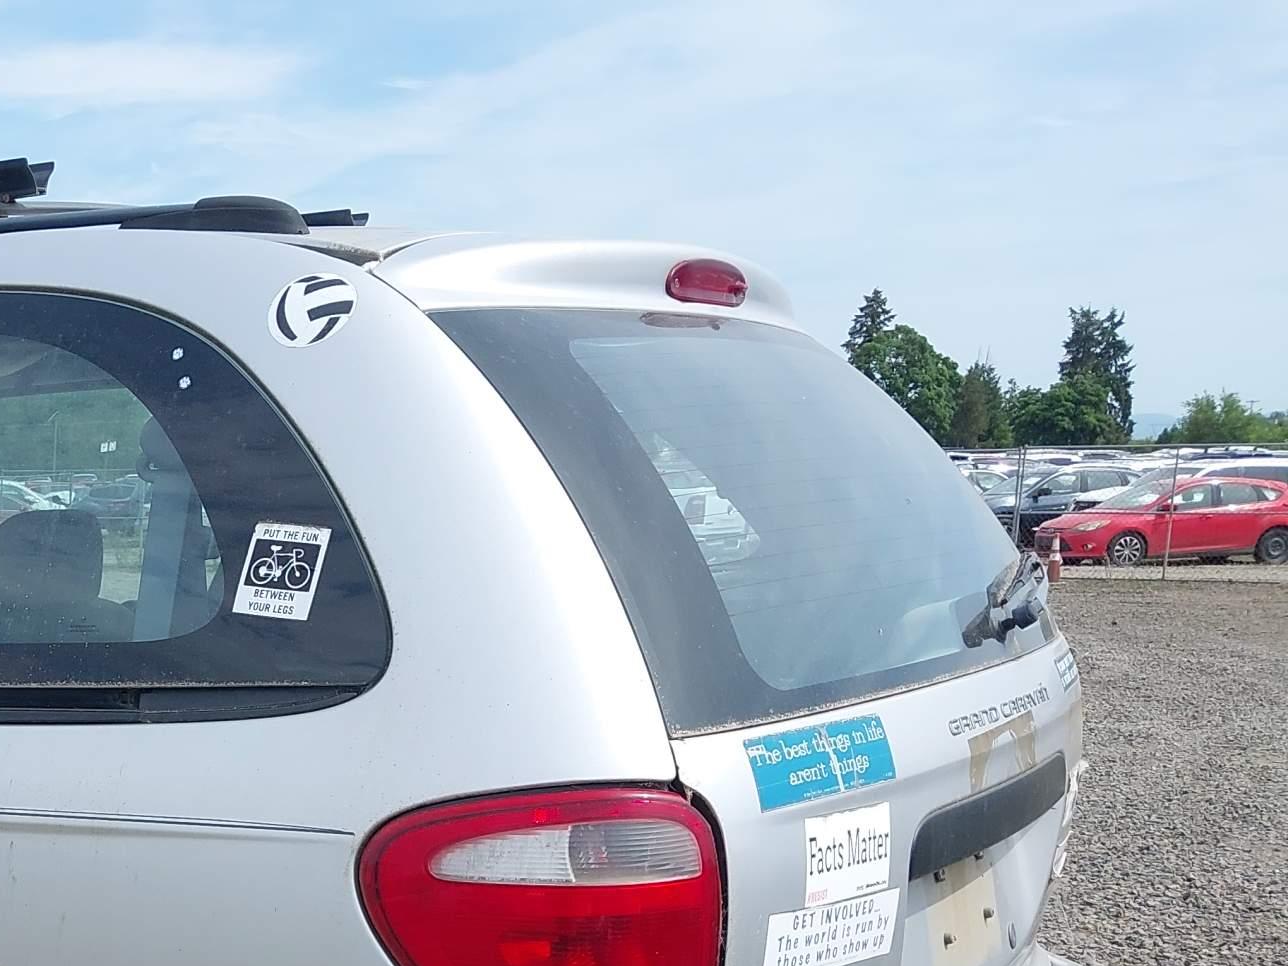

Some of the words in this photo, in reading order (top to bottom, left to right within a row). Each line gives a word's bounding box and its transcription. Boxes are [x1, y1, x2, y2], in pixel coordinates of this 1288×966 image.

[263, 528, 281, 539] PUT
[283, 530, 300, 541] THE
[301, 531, 320, 542] FUN
[248, 600, 271, 613] YOUR
[272, 604, 295, 615] LEGS
[253, 588, 295, 602] BETWEEN
[948, 706, 1000, 737] GRAND
[999, 687, 1050, 719] CARAVAN
[749, 744, 783, 766] The
[779, 738, 812, 760] best
[852, 730, 867, 745] in
[863, 720, 884, 743] life
[789, 762, 829, 785] aren't
[829, 755, 870, 774] things
[809, 835, 844, 876] Facts
[847, 826, 889, 867] Matter
[778, 934, 799, 953] The
[805, 924, 838, 947] world
[842, 923, 851, 938] is
[855, 919, 873, 935] run
[877, 914, 889, 930] by
[793, 911, 816, 931] GET
[816, 943, 838, 962] who
[843, 938, 869, 955] show
[873, 934, 885, 950] up
